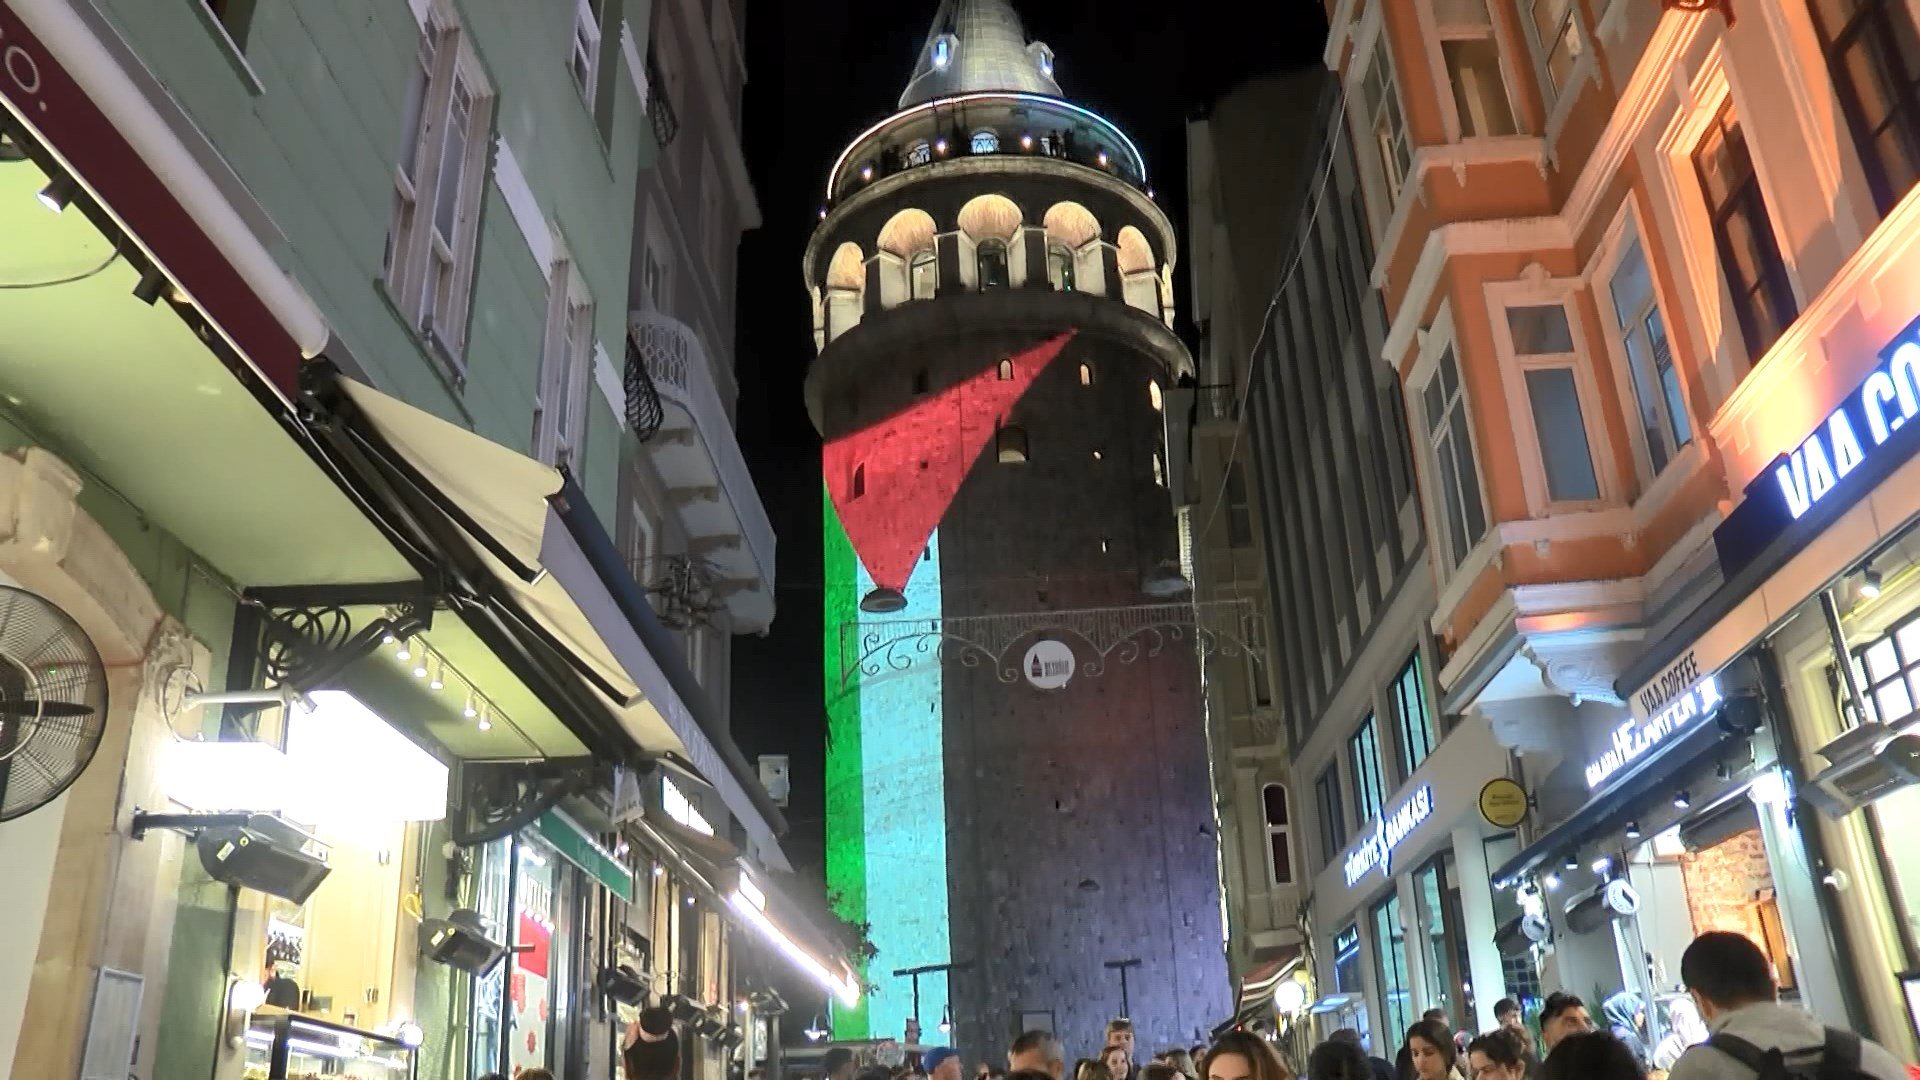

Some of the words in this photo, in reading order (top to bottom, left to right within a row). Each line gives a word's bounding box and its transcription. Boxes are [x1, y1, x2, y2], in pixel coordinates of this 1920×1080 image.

[1775, 407, 1866, 520] VAA
[1862, 330, 1920, 446] CO
[1640, 684, 1664, 717] VAA
[1661, 650, 1700, 701] COFFEE
[1385, 785, 1431, 850] BANKASI
